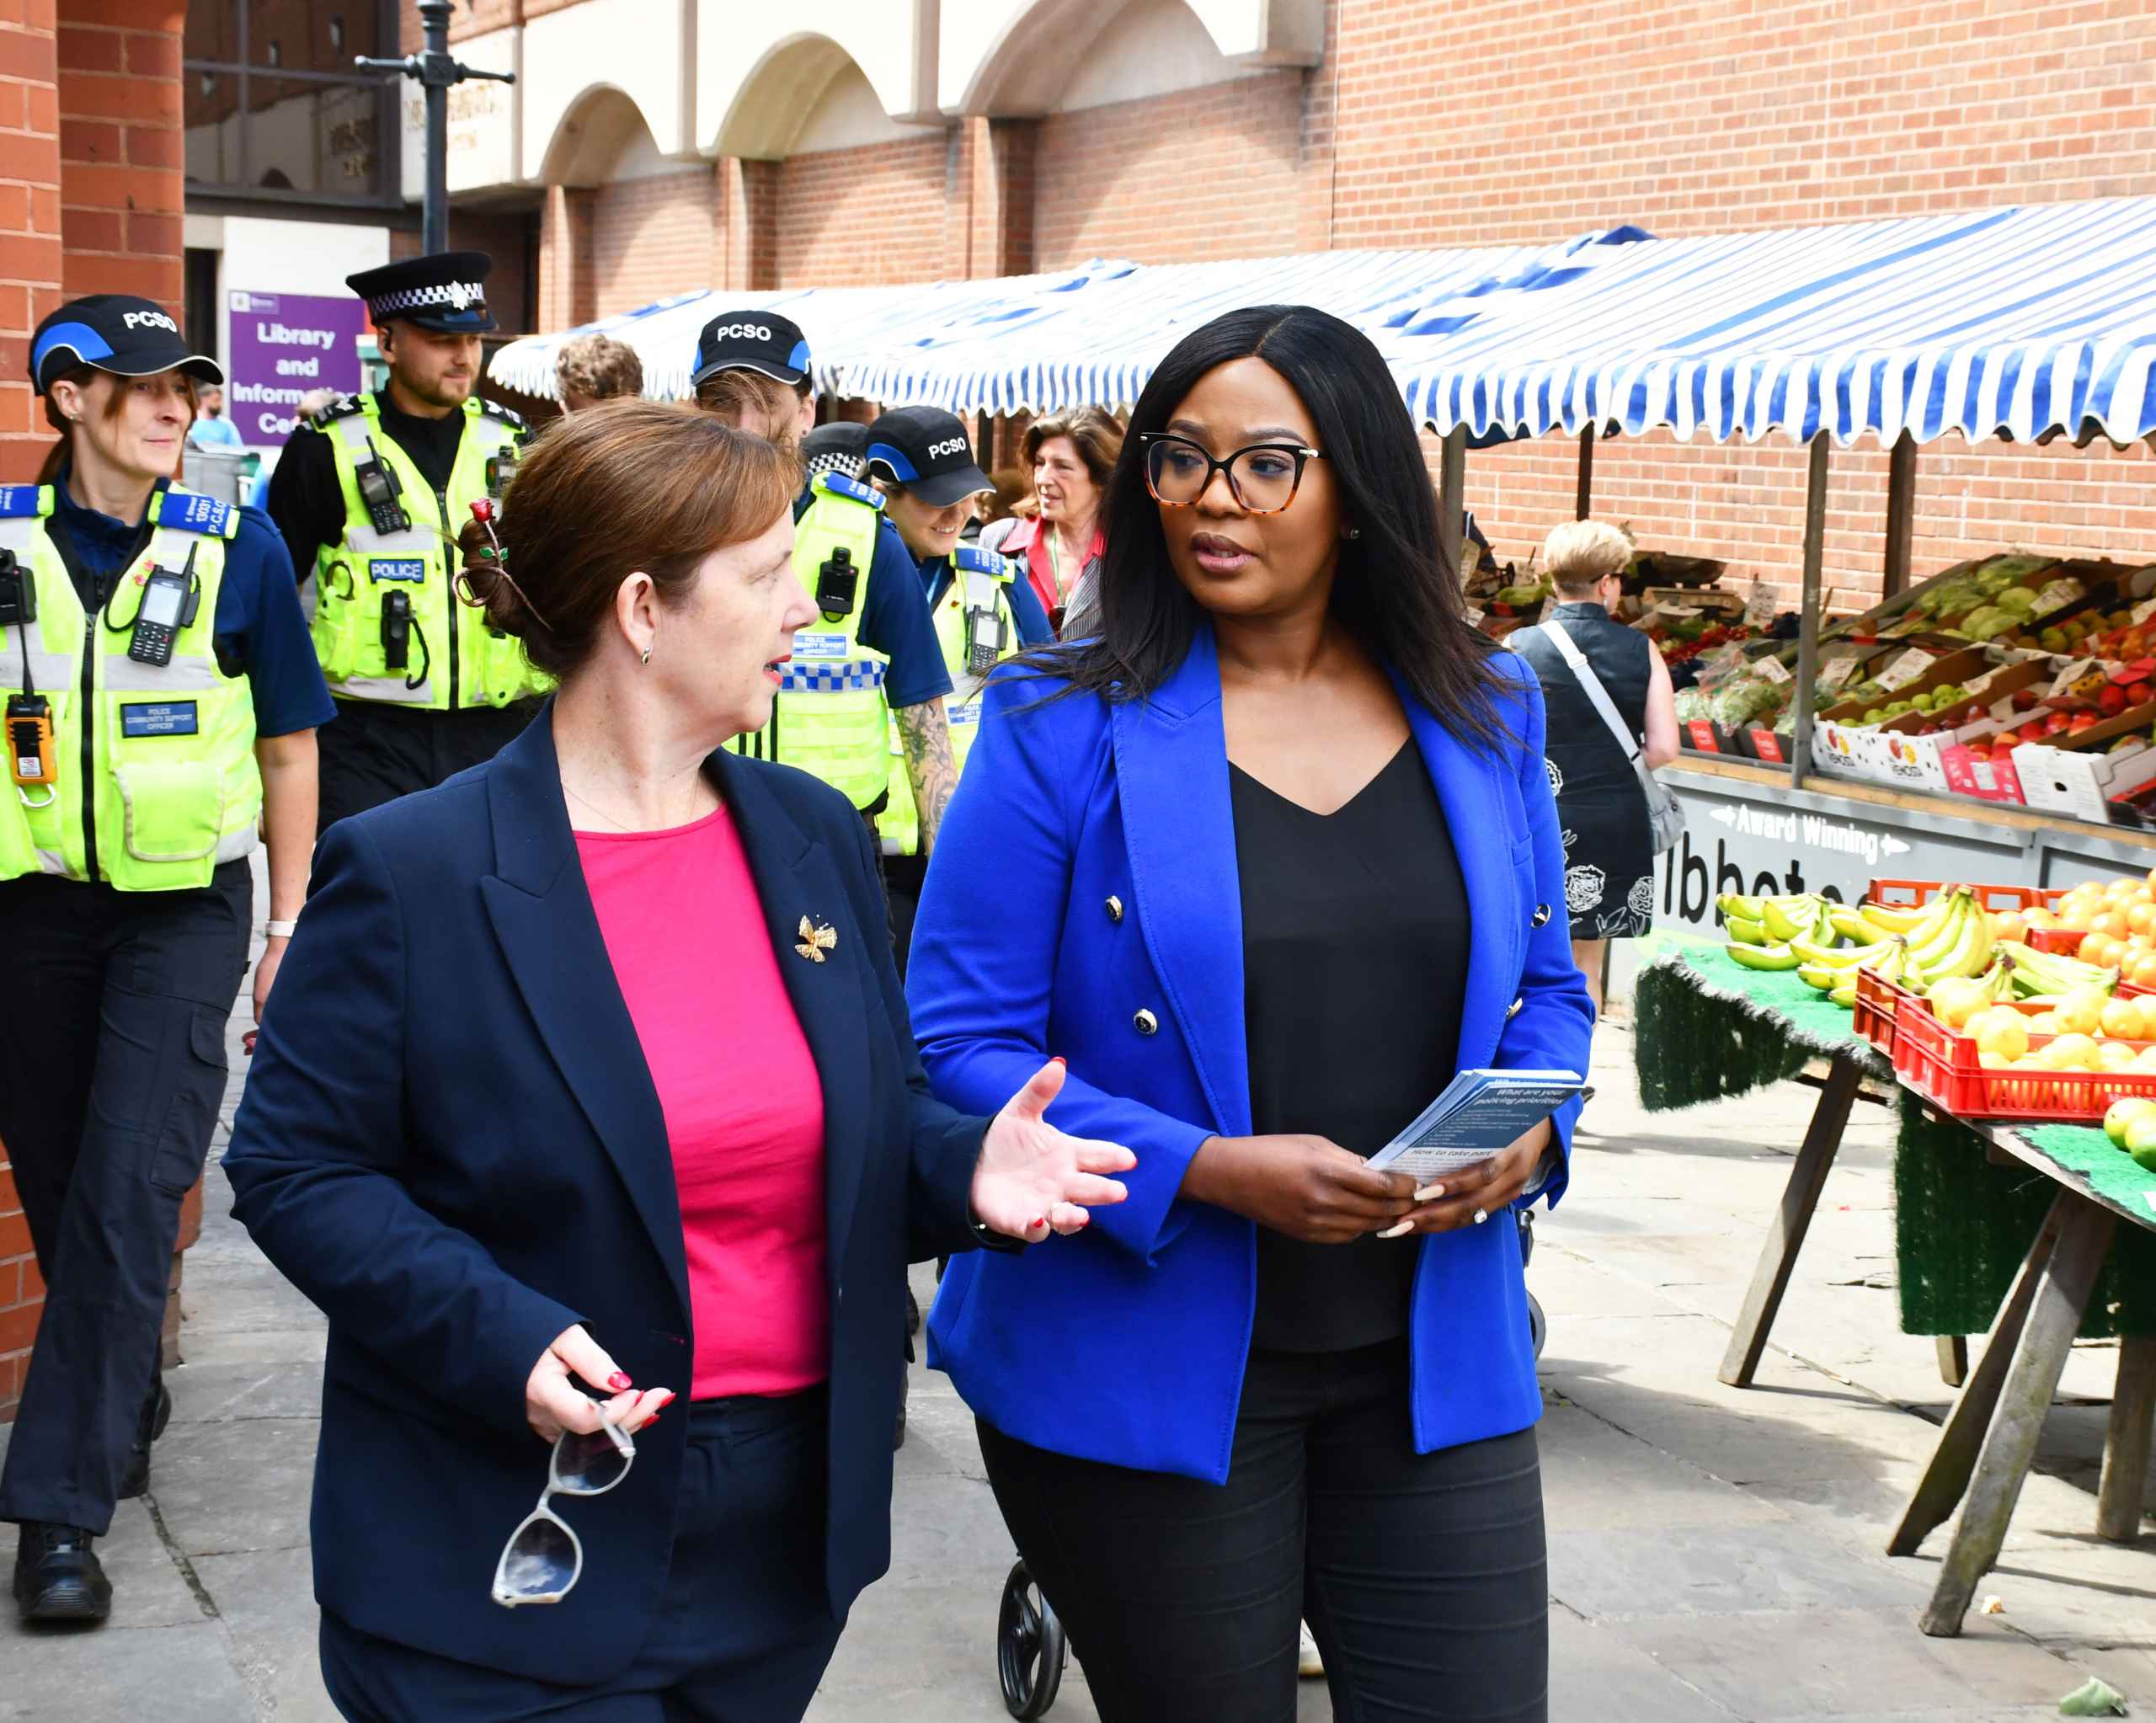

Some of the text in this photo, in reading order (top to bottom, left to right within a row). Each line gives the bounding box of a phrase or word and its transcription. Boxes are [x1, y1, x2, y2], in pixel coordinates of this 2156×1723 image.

[122, 311, 179, 333] PCSO
[257, 323, 336, 349] Library
[718, 323, 772, 342] PCSO
[276, 357, 319, 376] and
[232, 381, 356, 406] Inform
[928, 436, 966, 460] PCSO
[371, 563, 422, 578] POLICE
[125, 712, 193, 724] COMMUNITY SUPPORT
[147, 707, 171, 716] POLICE
[147, 722, 174, 730] OFFICER
[1736, 803, 1878, 866] Award Winning
[1474, 1096, 1514, 1107] policing
[1497, 1088, 1524, 1096] What
